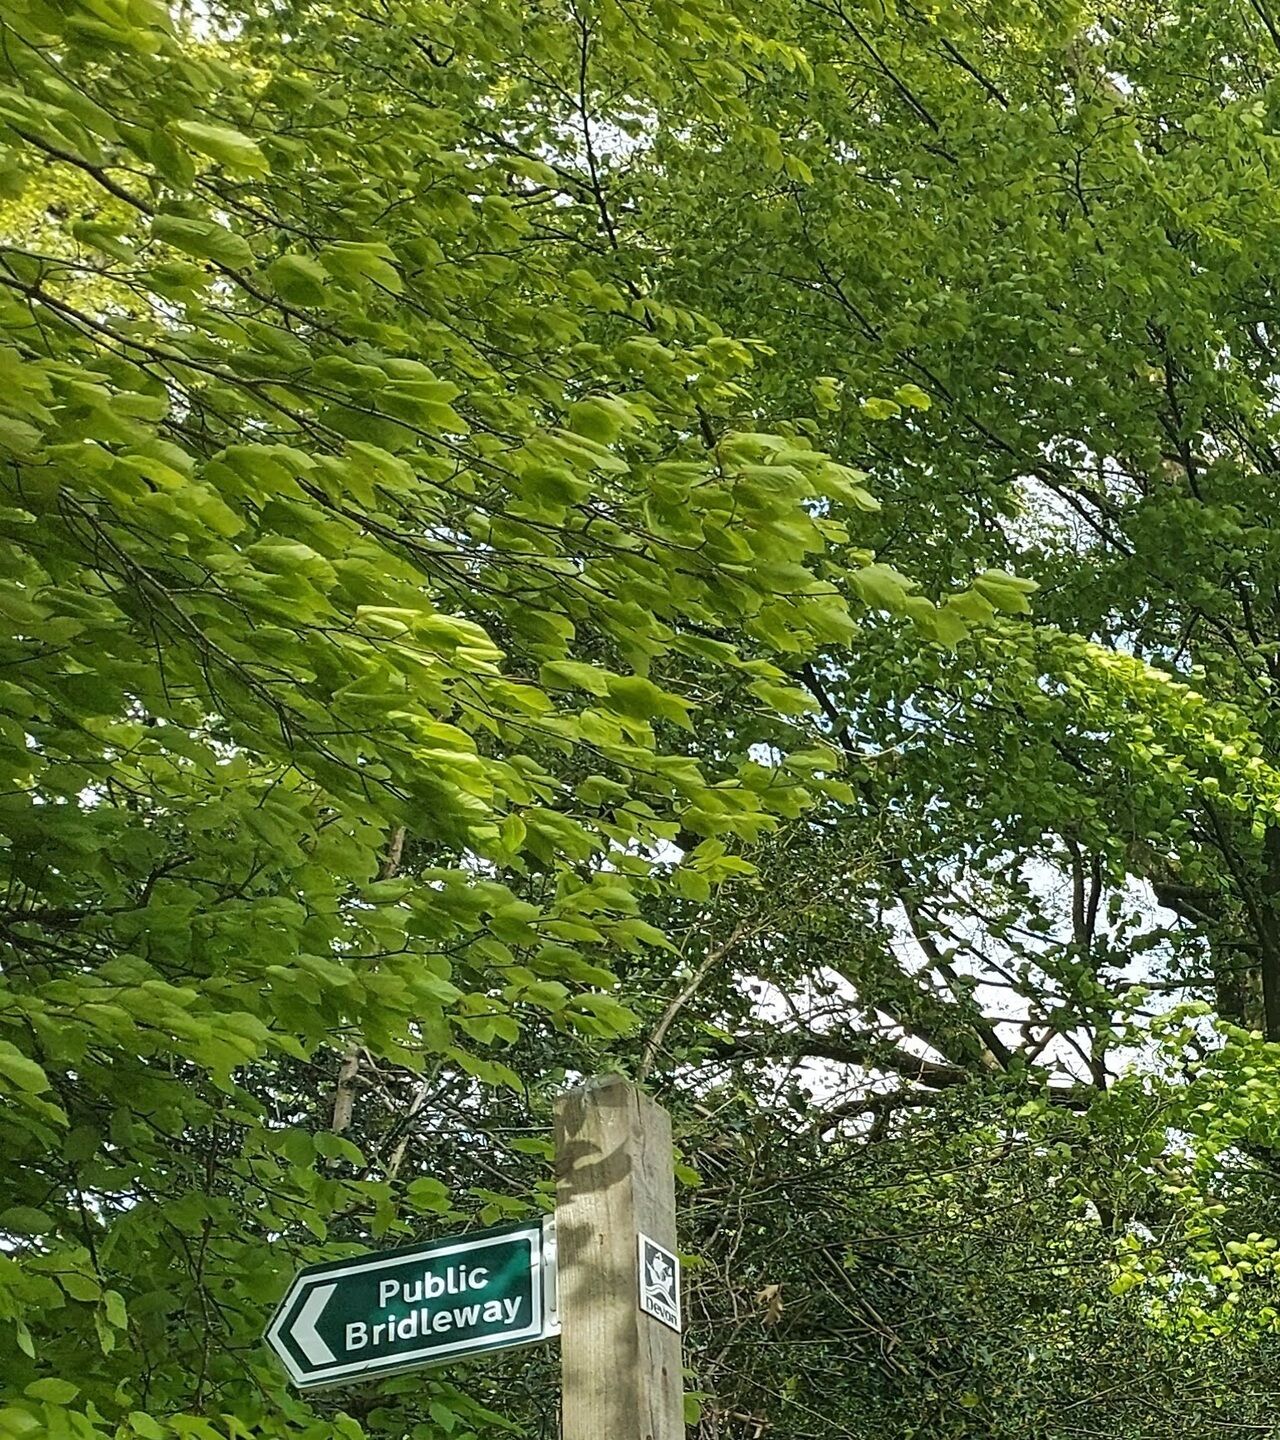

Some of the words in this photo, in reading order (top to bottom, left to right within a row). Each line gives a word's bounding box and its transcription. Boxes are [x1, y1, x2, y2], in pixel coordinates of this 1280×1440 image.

[379, 1264, 489, 1309] Public
[344, 1295, 522, 1351] Bridleway
[646, 1296, 677, 1326] Devon
